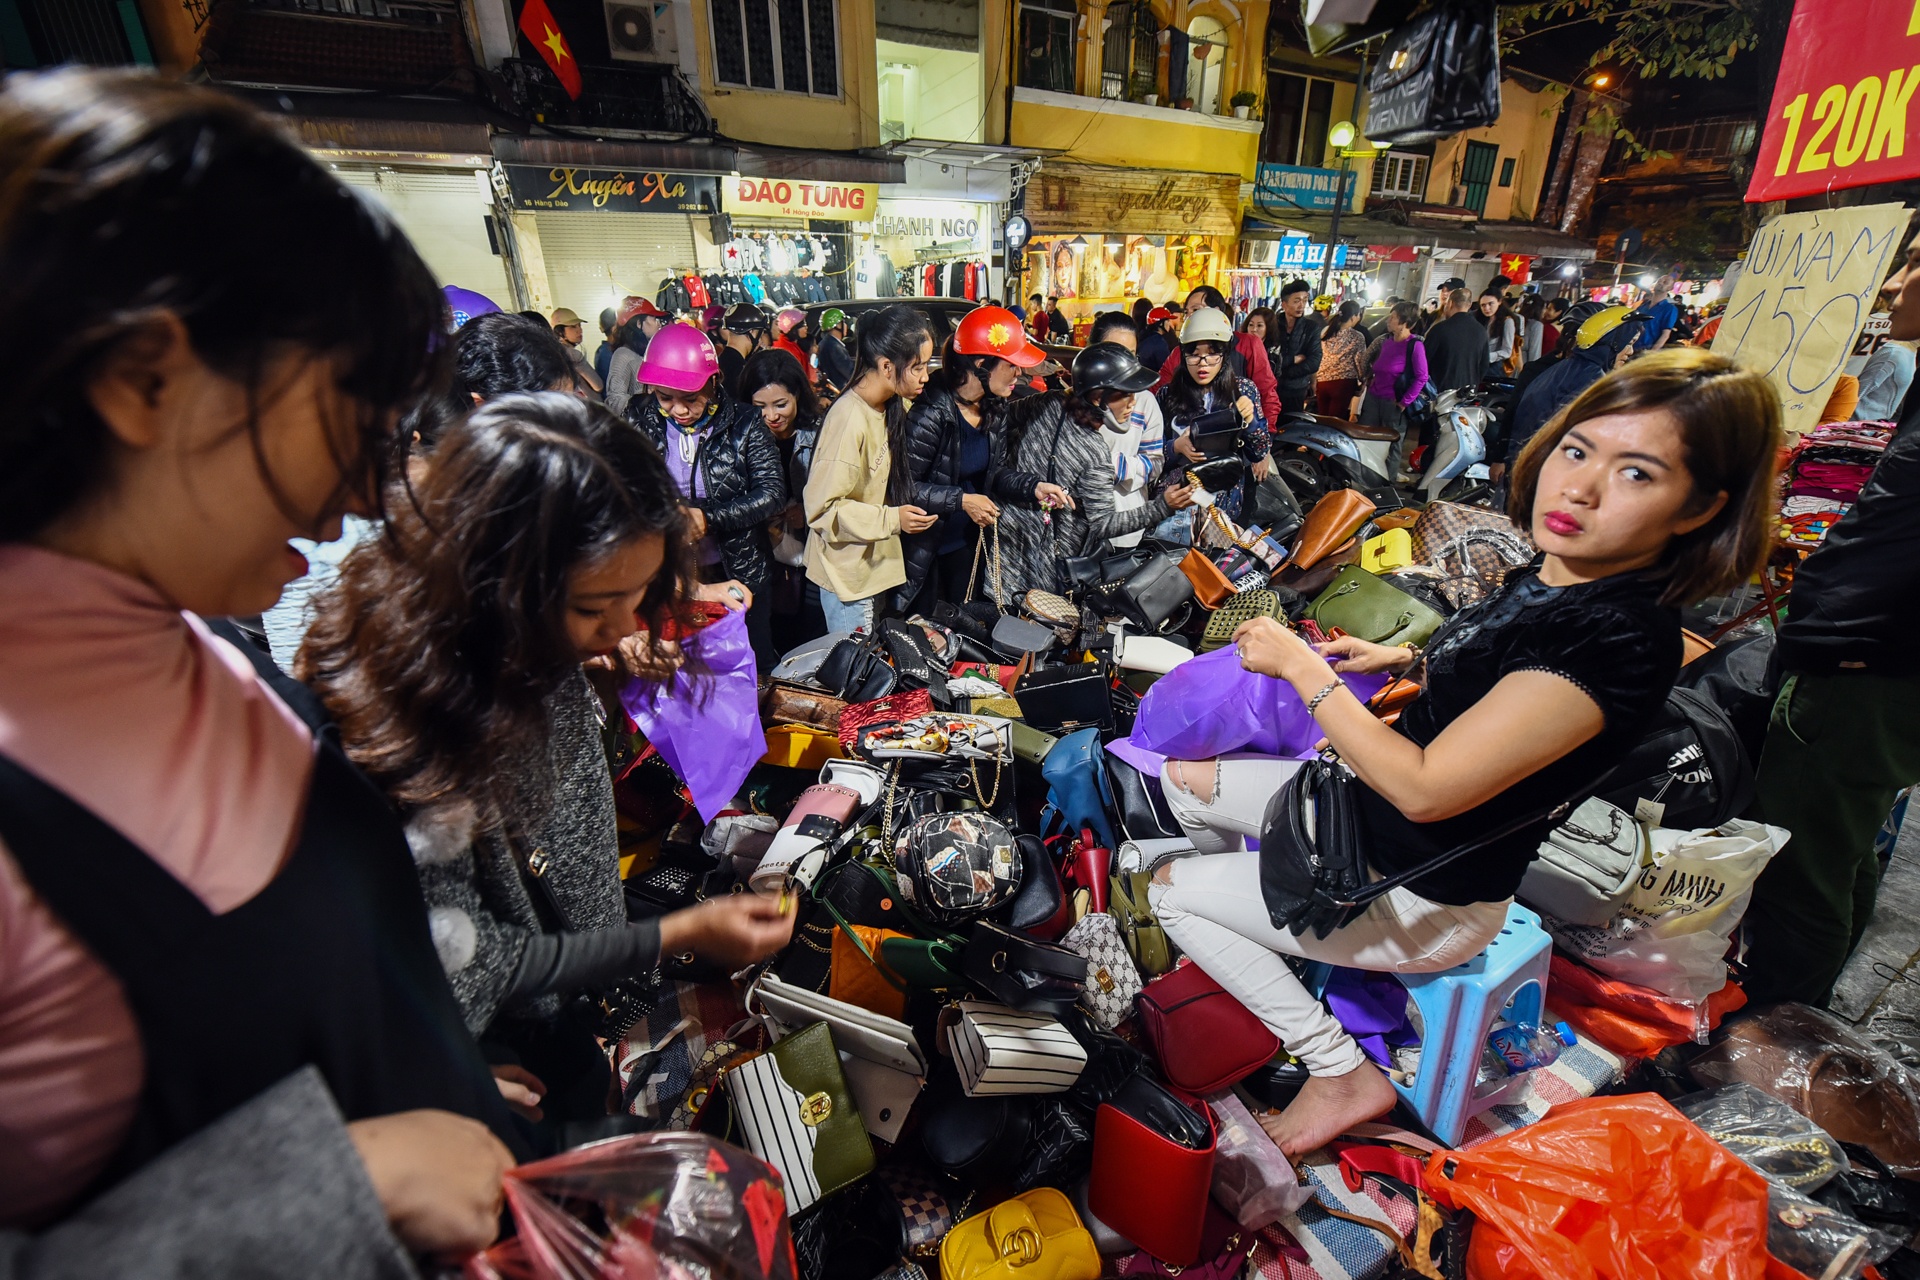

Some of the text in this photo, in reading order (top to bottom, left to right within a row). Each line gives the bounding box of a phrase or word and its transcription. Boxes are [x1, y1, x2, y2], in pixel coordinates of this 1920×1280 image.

[1774, 64, 1920, 177] 120K
[546, 167, 636, 207] Xuyên
[1330, 175, 1354, 193] RET
[1107, 176, 1212, 224] gallery
[782, 207, 790, 215] 14
[1281, 239, 1306, 263] LÊ
[1864, 321, 1892, 330] TSU
[1659, 869, 1726, 908] MINH
[1653, 898, 1700, 916] SPORT
[1588, 949, 1607, 959] Sport
